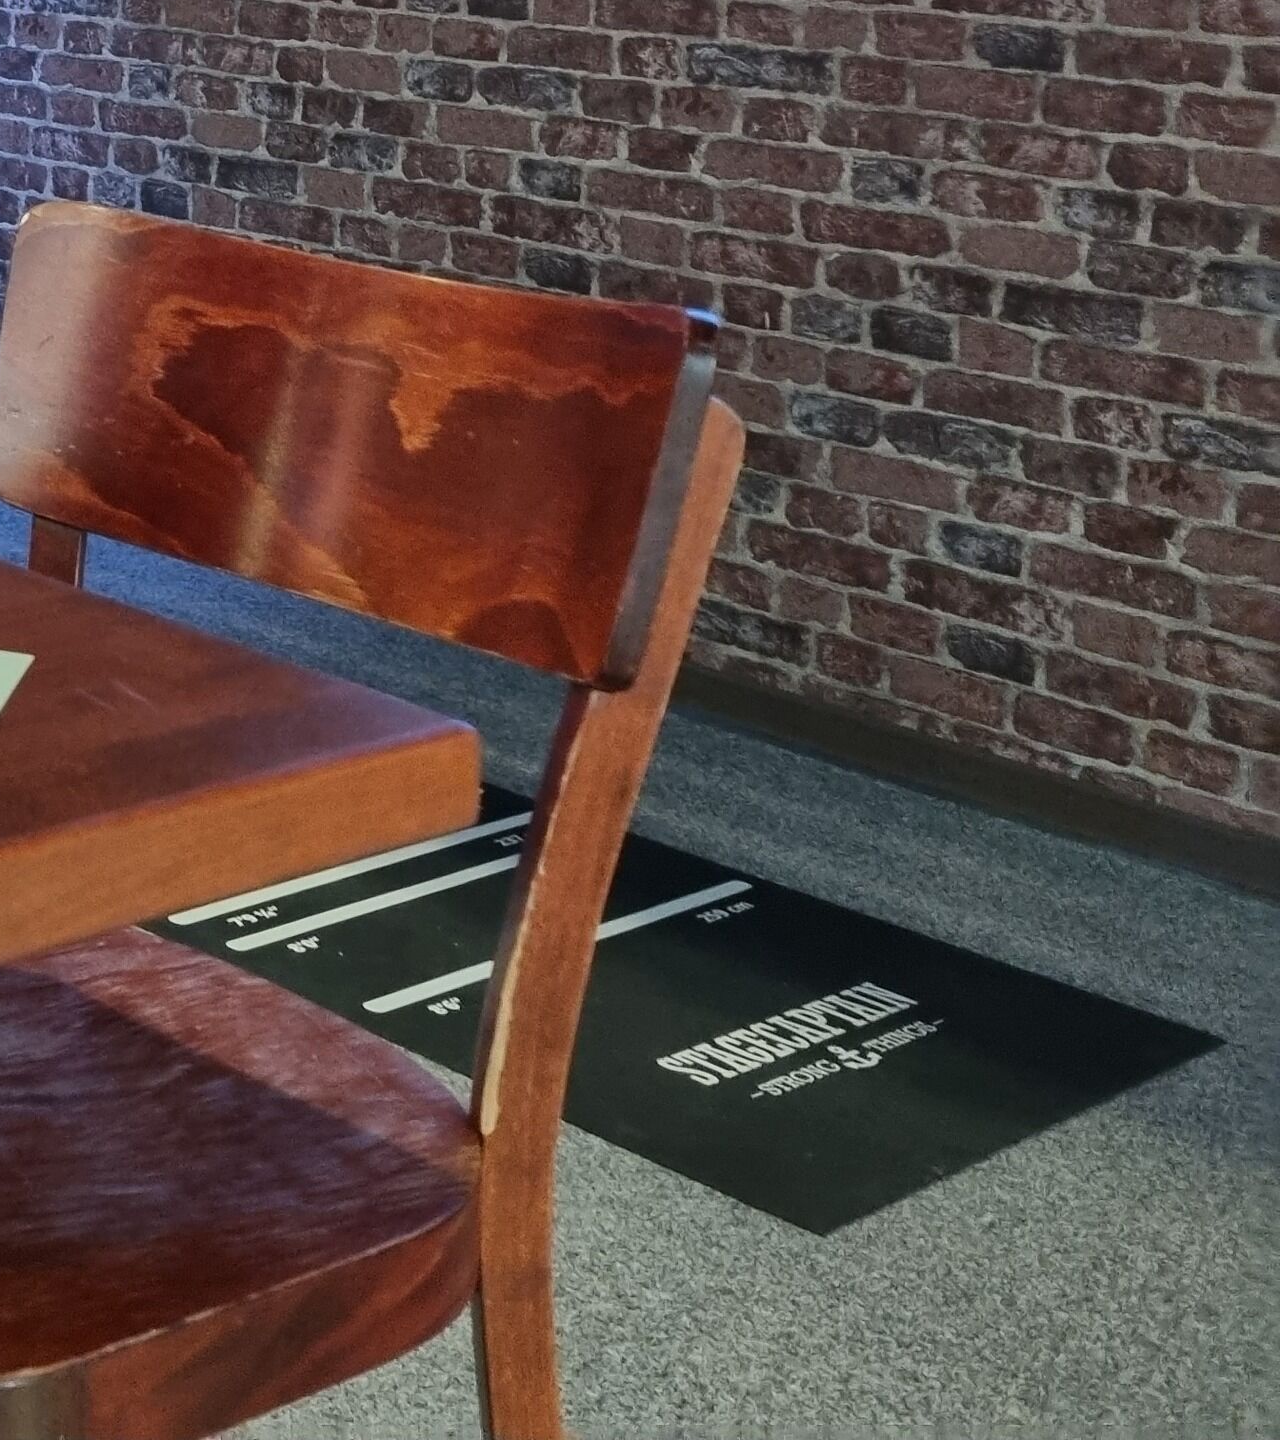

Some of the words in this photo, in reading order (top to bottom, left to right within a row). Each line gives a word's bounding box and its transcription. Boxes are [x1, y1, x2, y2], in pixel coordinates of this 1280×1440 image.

[696, 906, 730, 923] 259
[727, 901, 755, 916] cm
[656, 981, 919, 1086] STAGECAPTAIN
